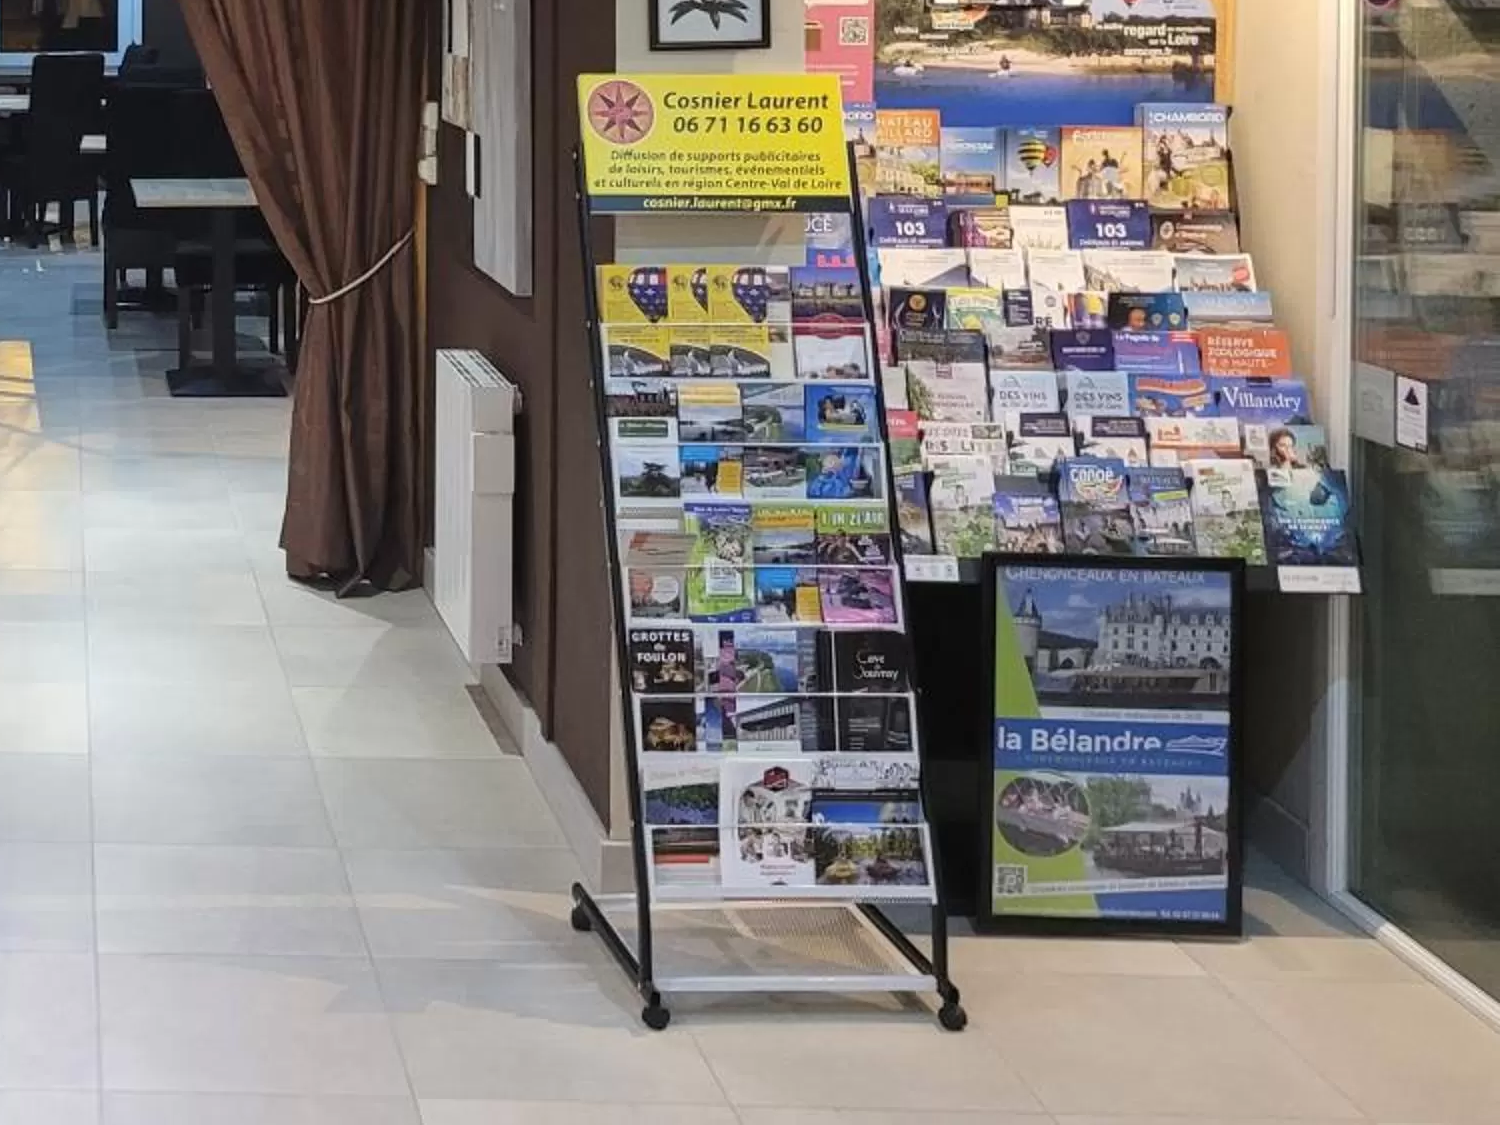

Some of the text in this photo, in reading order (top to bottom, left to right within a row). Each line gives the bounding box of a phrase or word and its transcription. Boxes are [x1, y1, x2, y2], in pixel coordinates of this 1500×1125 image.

[1124, 23, 1167, 39] regard
[663, 91, 828, 110] Cosnier Laurent
[673, 117, 823, 133] 06 71 16 63 60
[876, 116, 933, 127] HATEAU
[876, 127, 933, 138] AILLARD
[611, 150, 821, 163] Diffusion de supports publicitaires
[609, 164, 622, 174] de
[626, 164, 664, 175] loisirs,
[735, 164, 825, 175] événementiels
[594, 178, 606, 188] et
[609, 177, 661, 188] culturels
[664, 180, 680, 188] en
[683, 177, 722, 191] région
[794, 178, 809, 189] de
[812, 179, 842, 189] Loire
[643, 196, 796, 211] cosnier.laurent@gmx.fr
[895, 221, 926, 236] 103
[1096, 223, 1127, 238] 103
[1222, 387, 1301, 411] Villandry
[631, 631, 690, 643] GROTTES
[637, 652, 687, 663] FOULON
[997, 726, 1162, 752] la Bélandre
